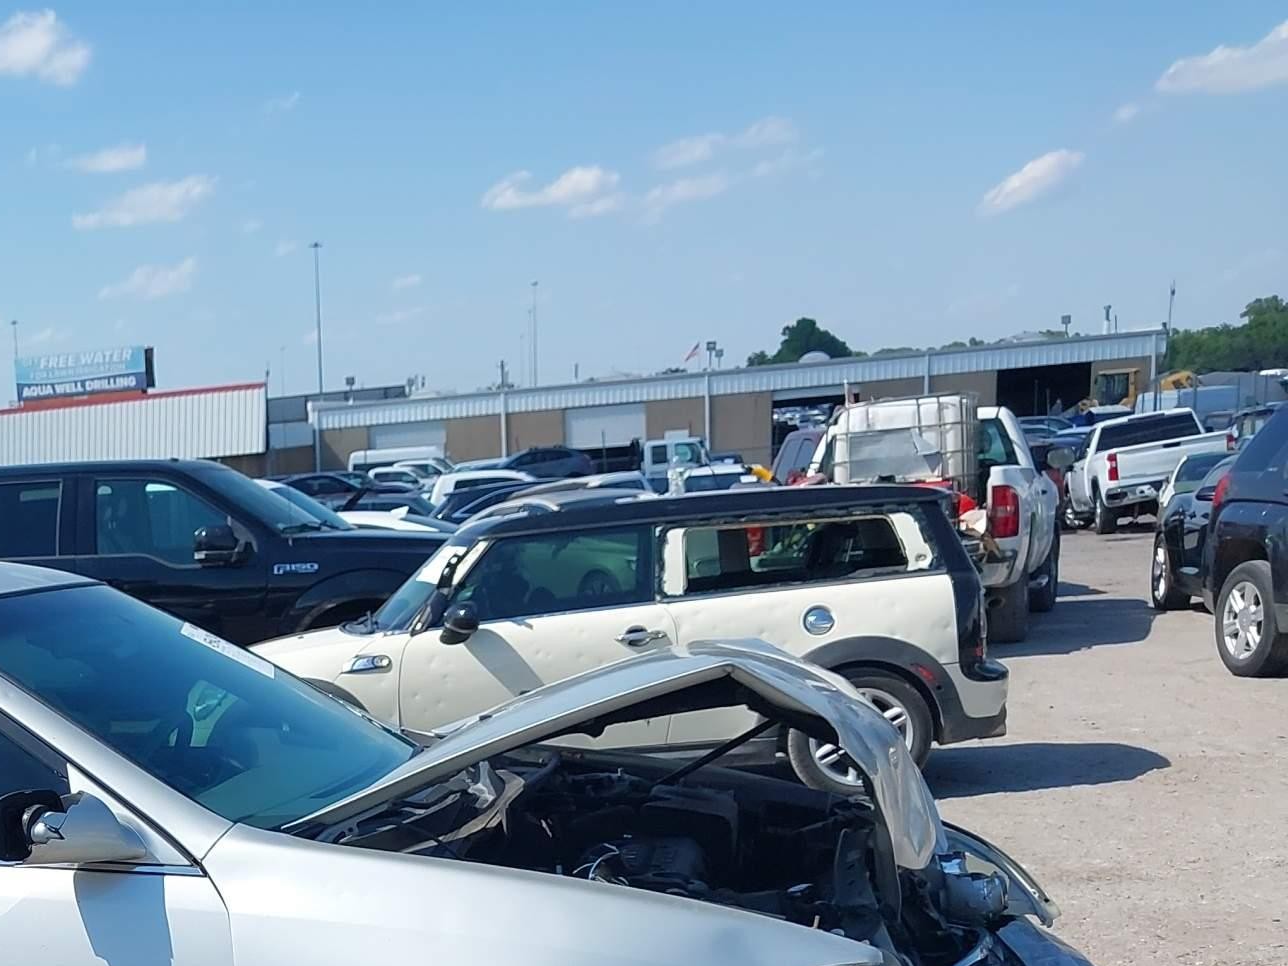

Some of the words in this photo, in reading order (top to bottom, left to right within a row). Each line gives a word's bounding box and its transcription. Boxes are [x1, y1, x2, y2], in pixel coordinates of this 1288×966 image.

[39, 354, 76, 369] FREE
[80, 348, 132, 366] WATER
[22, 384, 54, 397] AQUA
[55, 380, 84, 393] WELL
[85, 376, 137, 391] DRILLING
